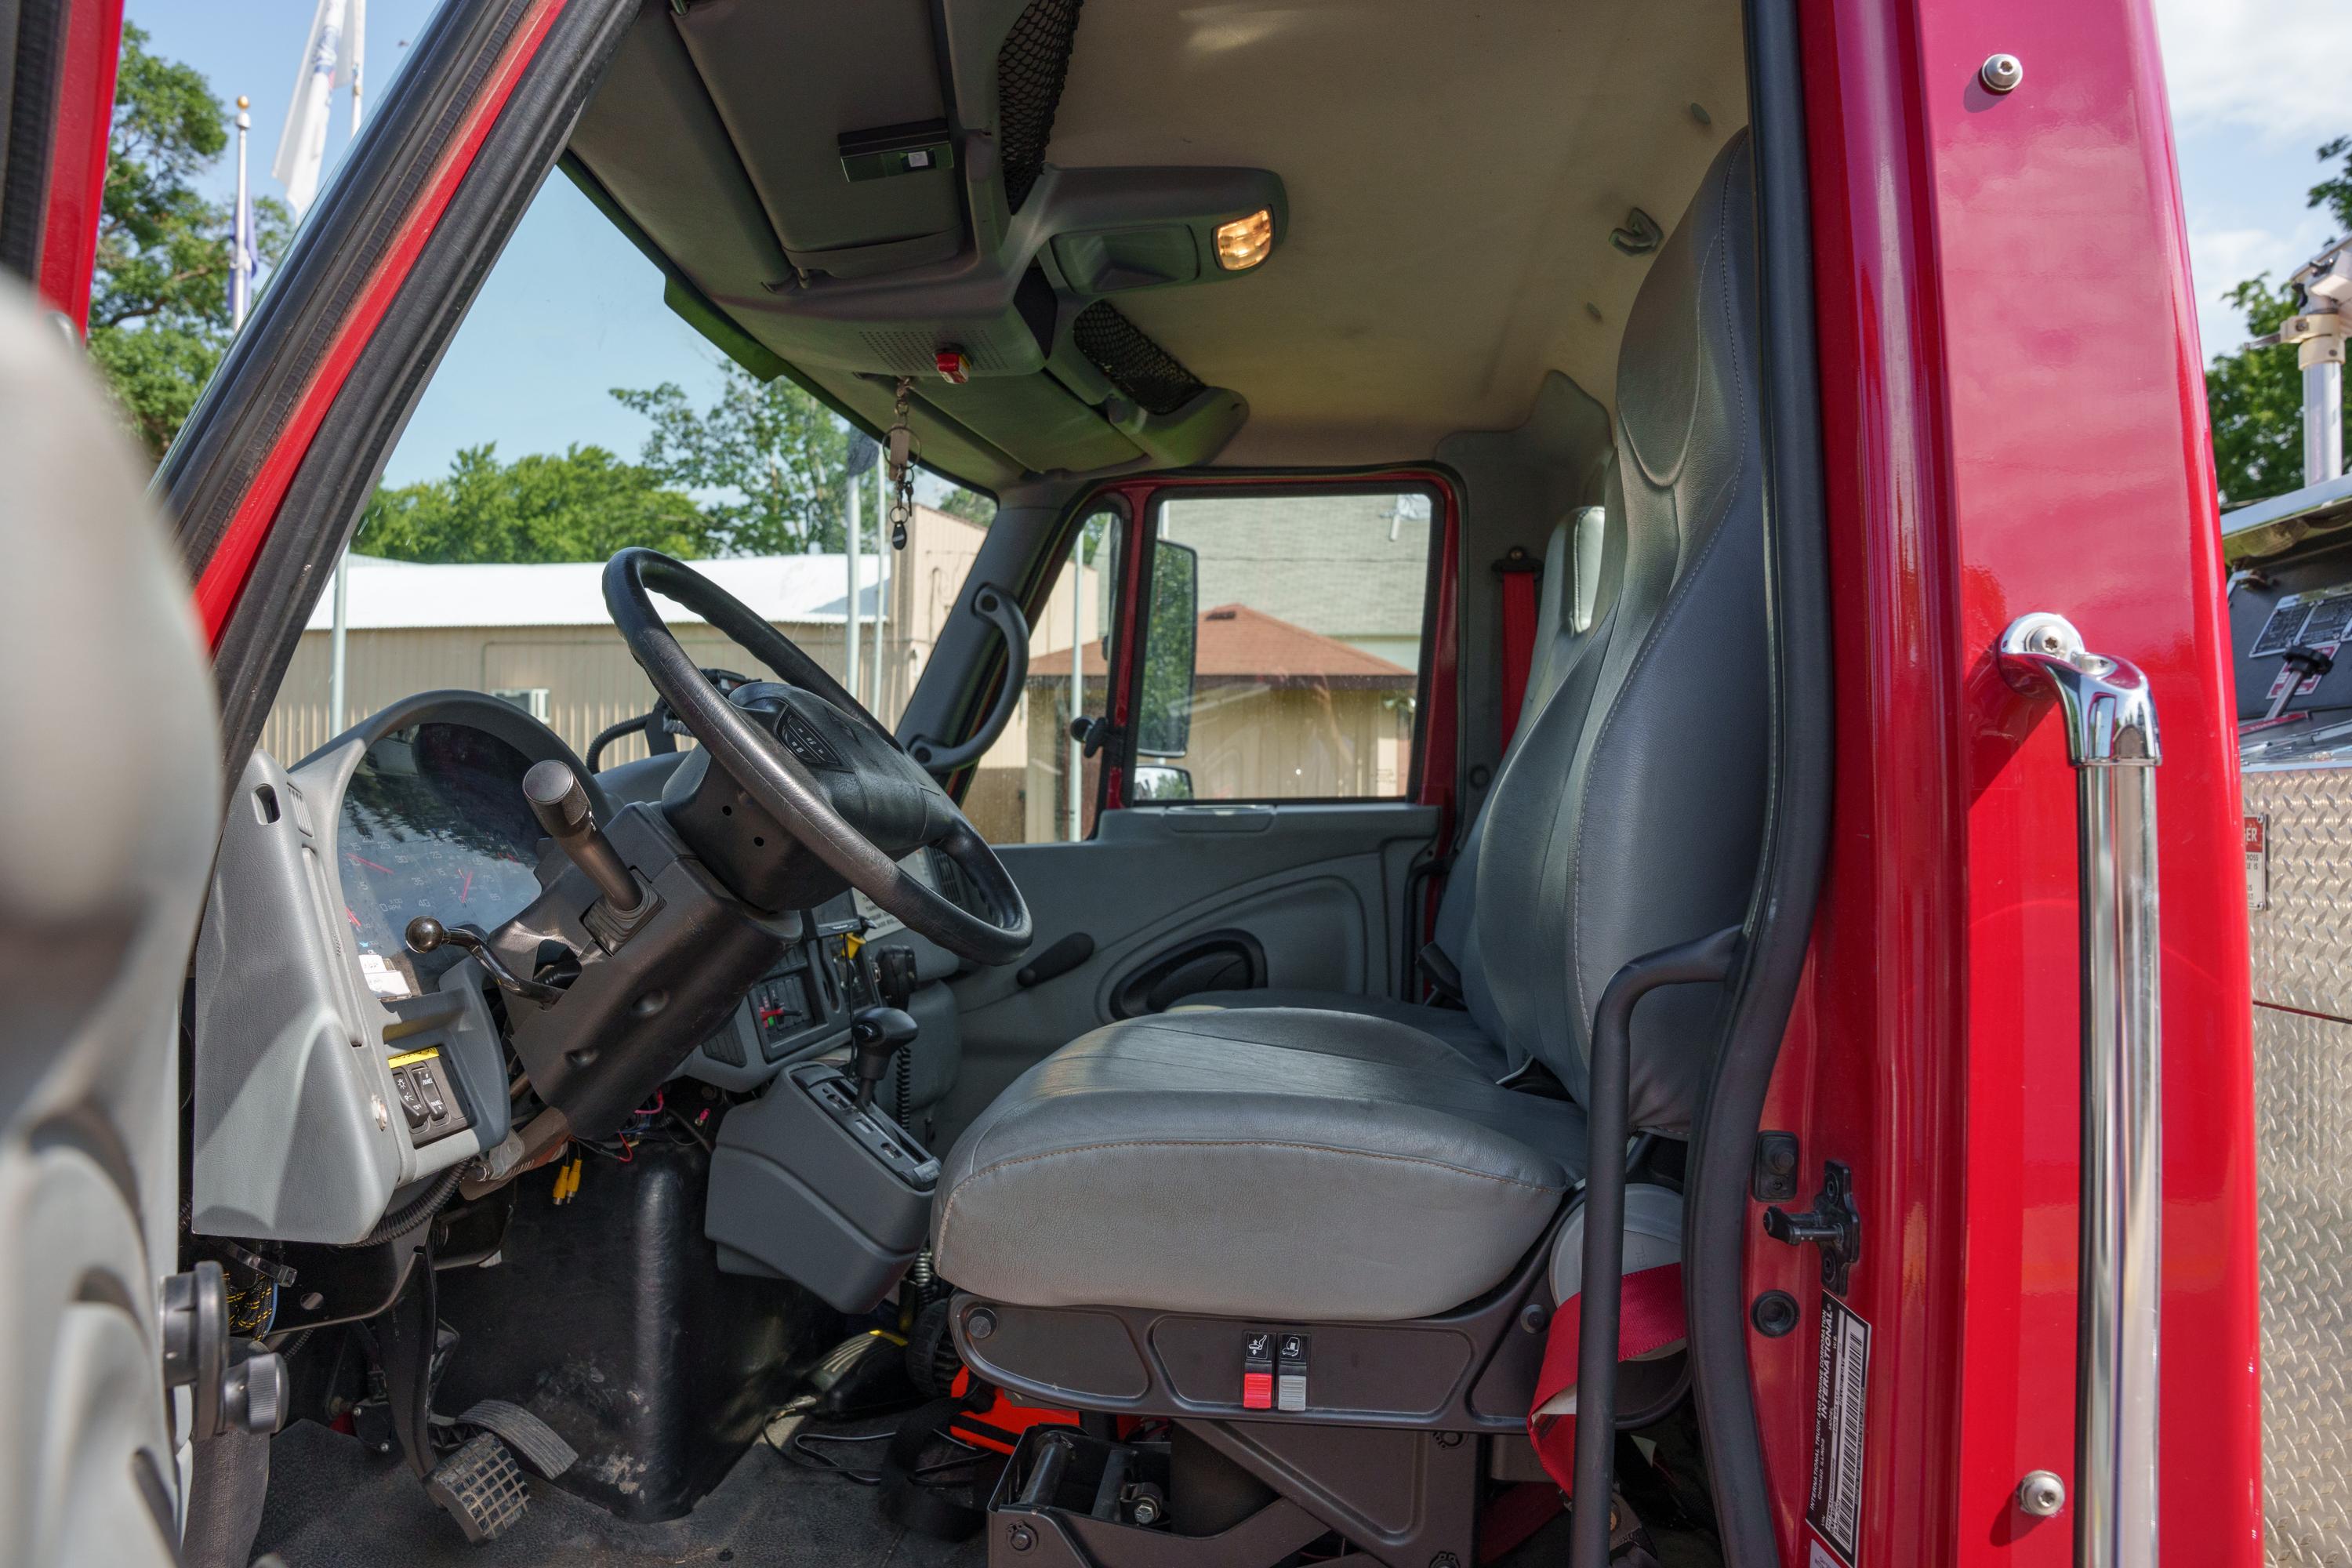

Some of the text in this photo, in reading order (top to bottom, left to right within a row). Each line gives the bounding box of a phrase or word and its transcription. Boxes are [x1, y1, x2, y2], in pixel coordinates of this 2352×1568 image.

[2246, 828, 2257, 841] ER
[350, 843, 361, 851] 15
[377, 841, 390, 850] 25
[395, 855, 408, 864] 30
[361, 881, 369, 891] 5
[412, 877, 424, 886] 35
[448, 886, 457, 895] 5
[419, 898, 431, 908] 40
[379, 903, 388, 913] 0
[1809, 1447, 1820, 1511] INTERNATIONAL
